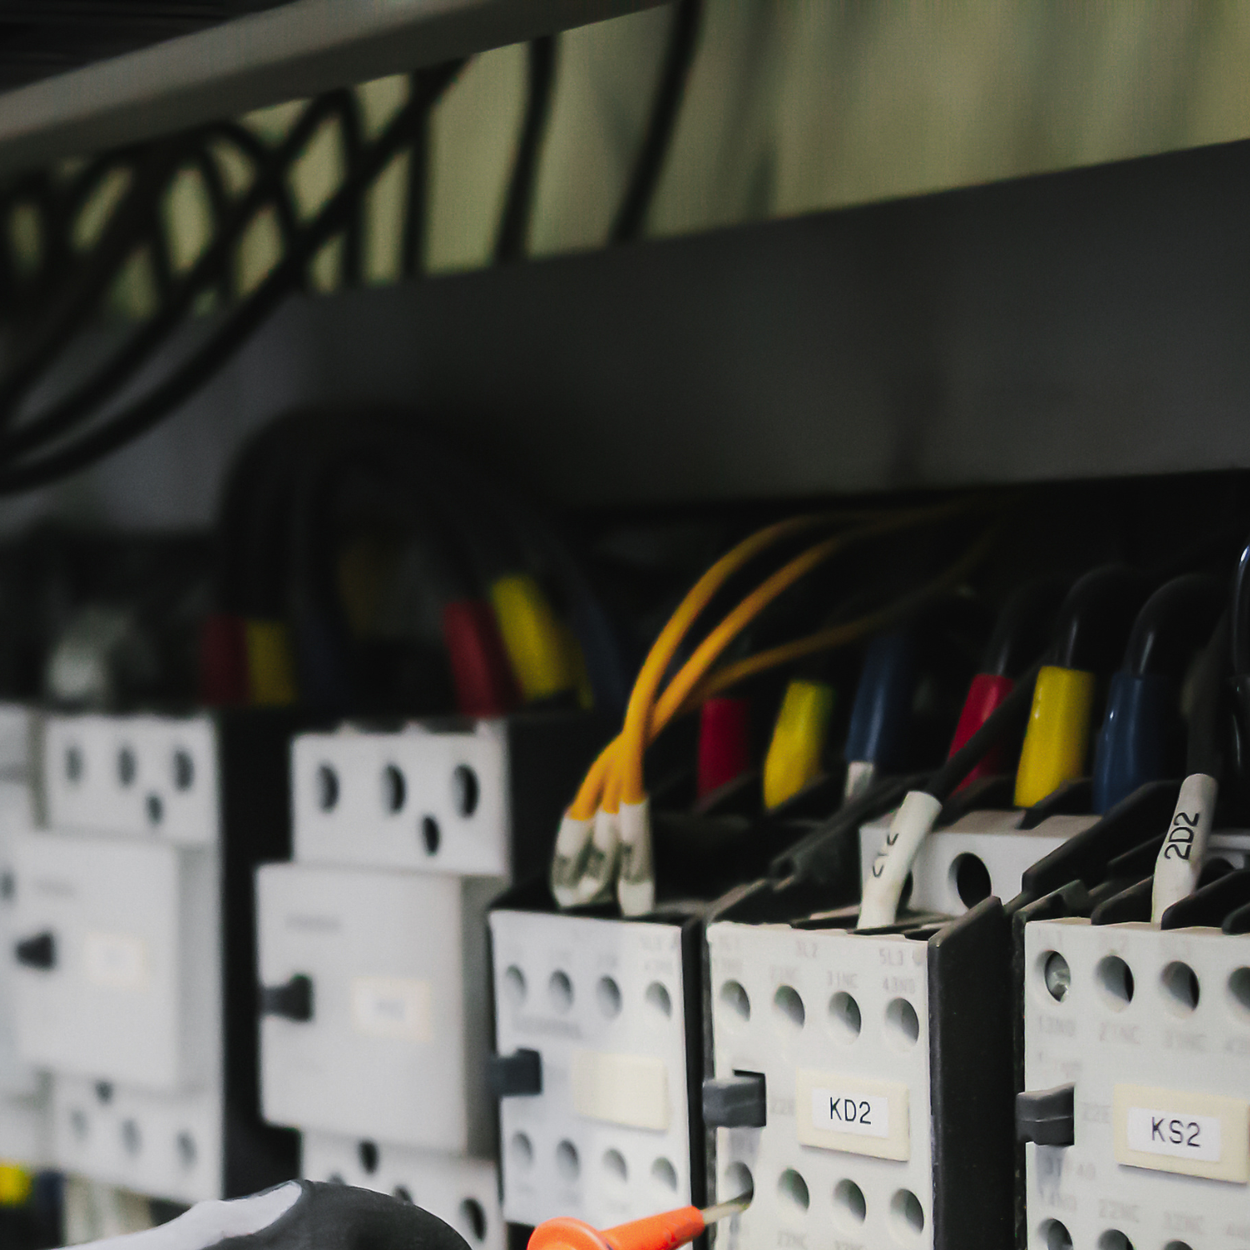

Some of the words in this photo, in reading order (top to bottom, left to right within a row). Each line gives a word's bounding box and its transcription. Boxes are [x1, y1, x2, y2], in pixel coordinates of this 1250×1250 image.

[1163, 811, 1200, 861] 2D2
[829, 1096, 872, 1126] KD2
[1150, 1116, 1202, 1149] KS2
